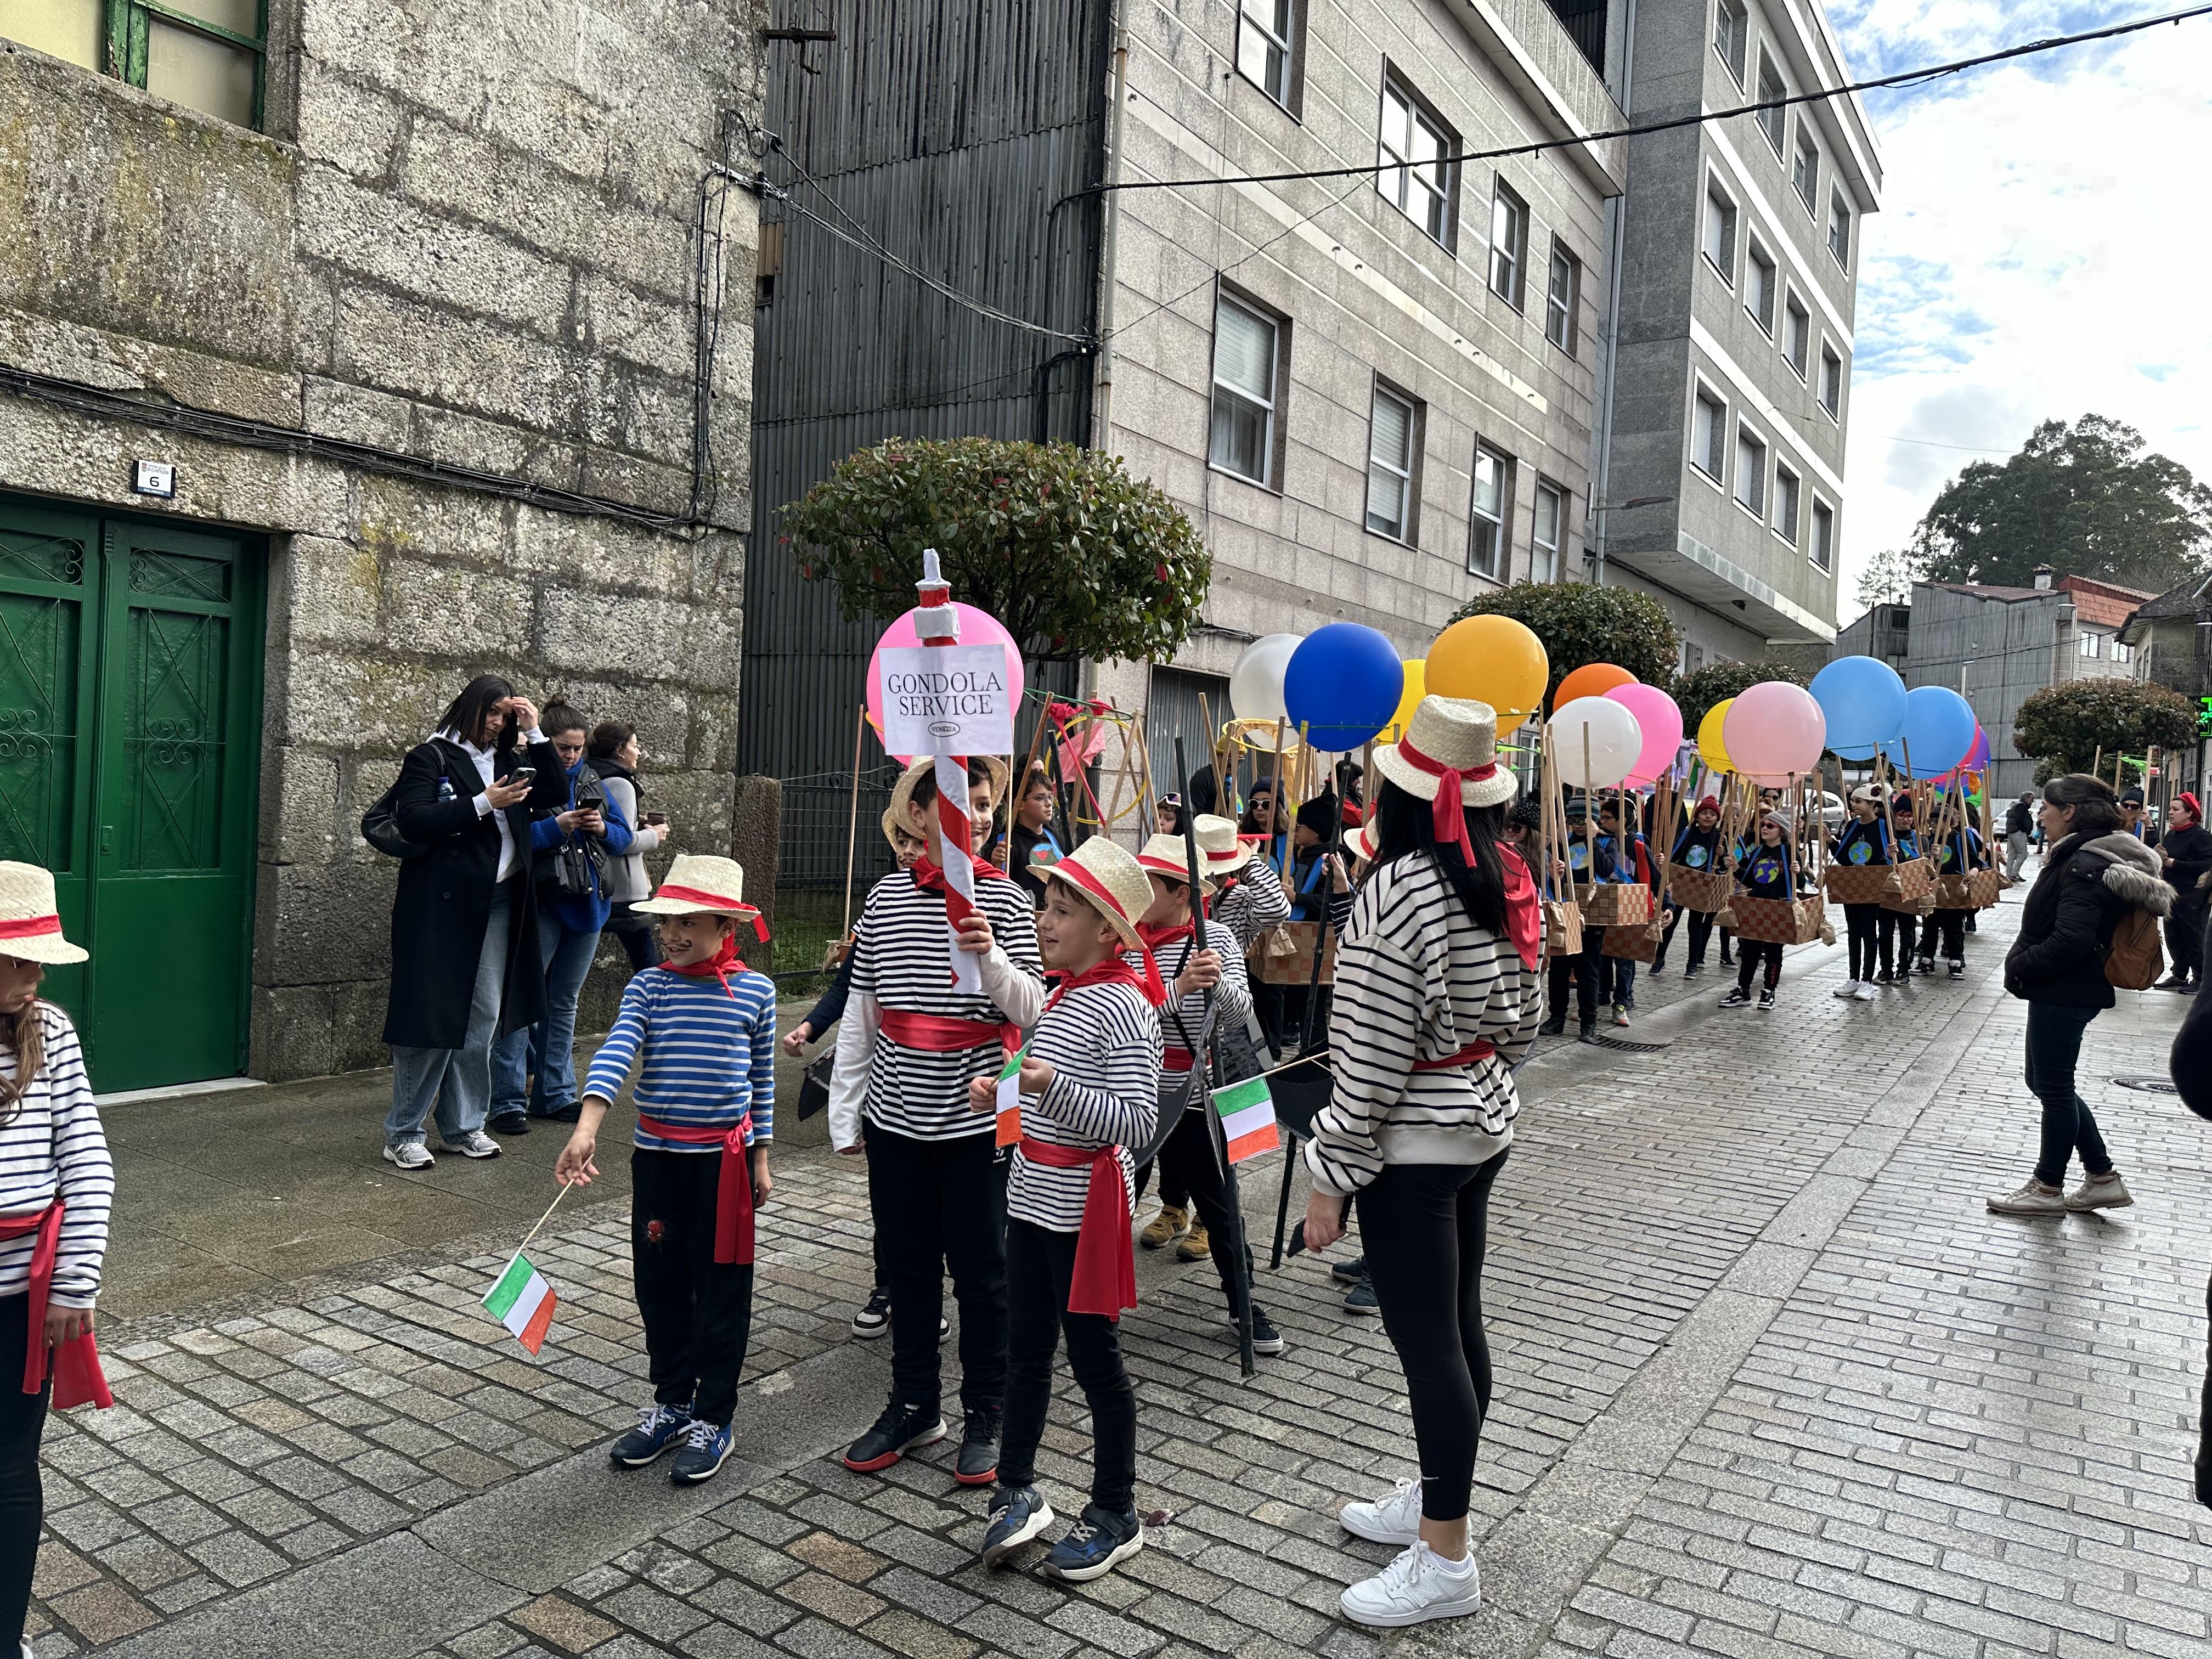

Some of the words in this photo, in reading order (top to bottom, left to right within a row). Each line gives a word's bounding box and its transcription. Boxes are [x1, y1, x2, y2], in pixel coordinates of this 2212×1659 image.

[150, 476, 159, 487] 6
[888, 672, 1003, 693] GONDOLA
[899, 694, 993, 716] SERVICE
